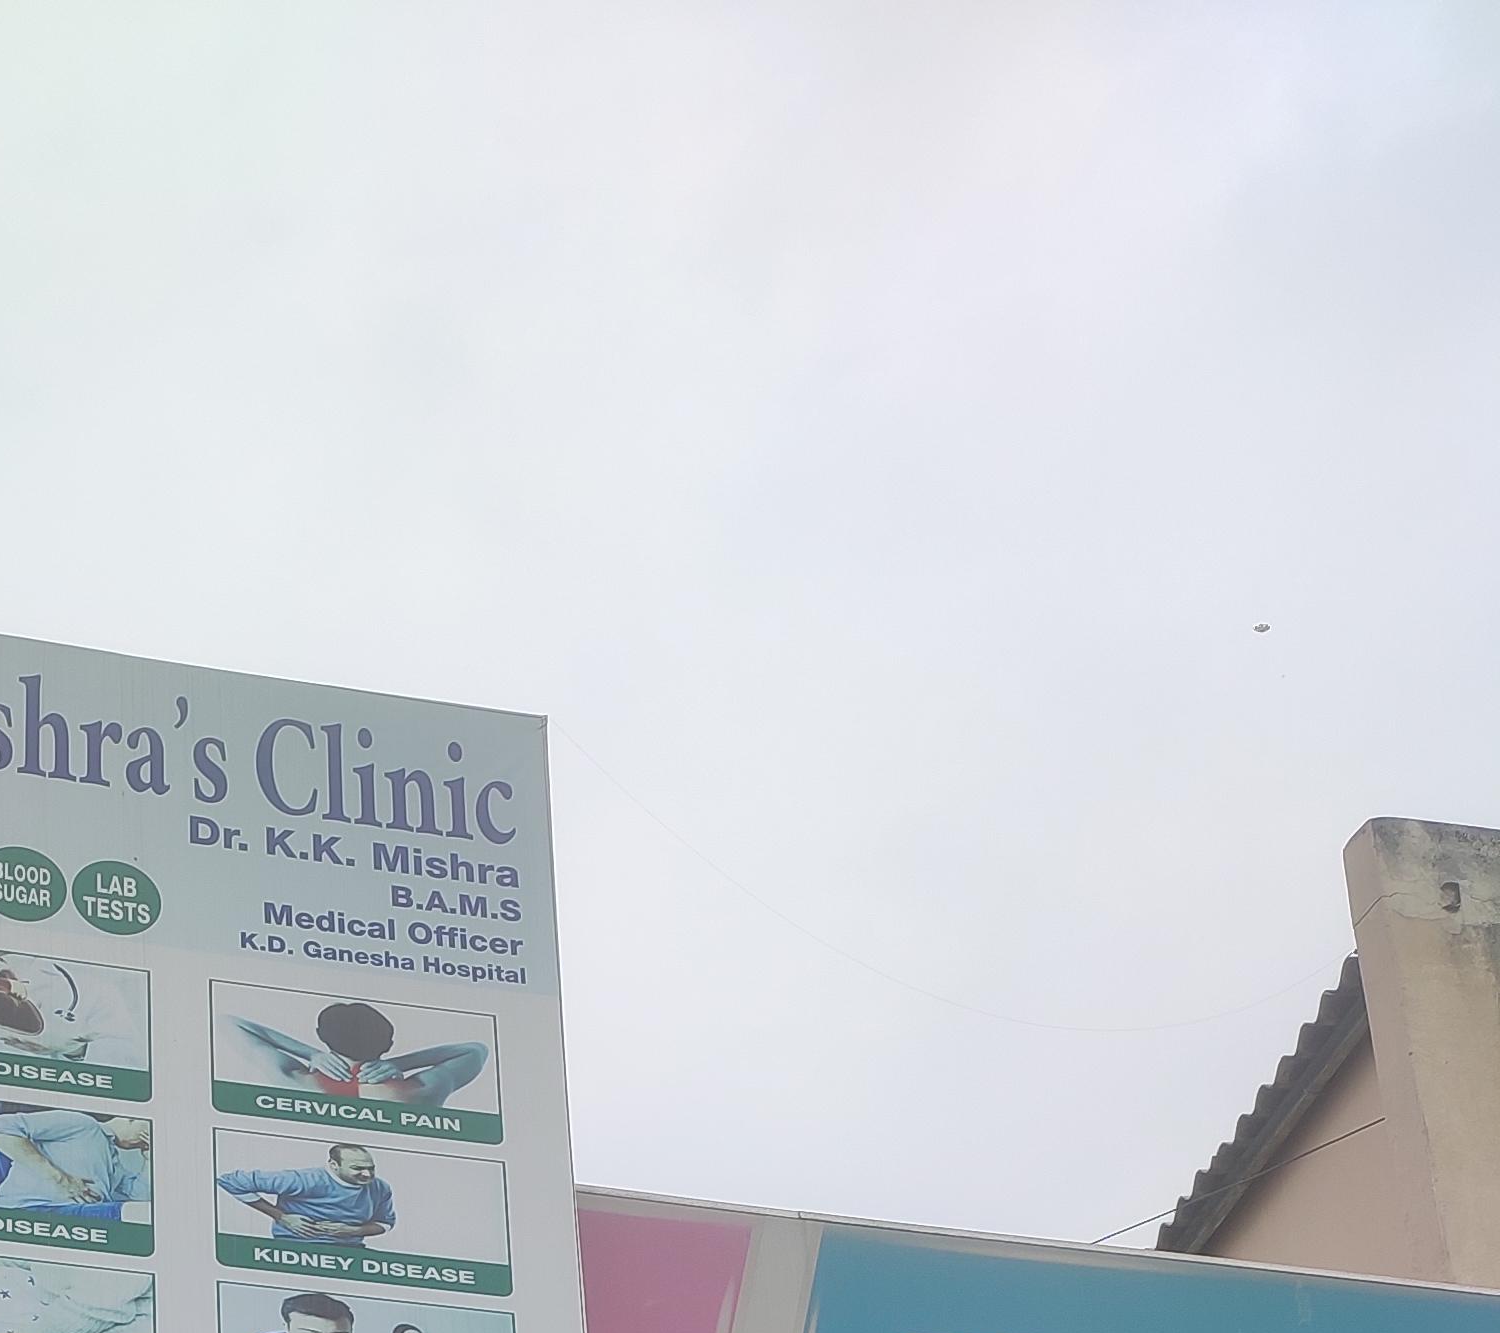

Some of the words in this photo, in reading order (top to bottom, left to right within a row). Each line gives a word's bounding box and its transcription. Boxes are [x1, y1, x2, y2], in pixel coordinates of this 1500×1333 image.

[255, 718, 517, 845] Clinic
[188, 815, 248, 852] Dr.
[265, 827, 355, 868] K.K.
[372, 842, 520, 889] Mishra
[95, 873, 138, 900] LAB
[391, 885, 522, 922] B.A.M.S
[82, 895, 152, 926] TESTS
[263, 902, 395, 942] Medical
[408, 920, 524, 956] Officer
[239, 932, 294, 957] K.D.
[302, 940, 415, 974] Ganesha
[422, 953, 527, 985] Hospital
[255, 1095, 392, 1124] CERVICAL
[400, 1112, 461, 1132] PAIN
[253, 1246, 354, 1272] KIDNEY
[362, 1259, 476, 1285] DISEASE
